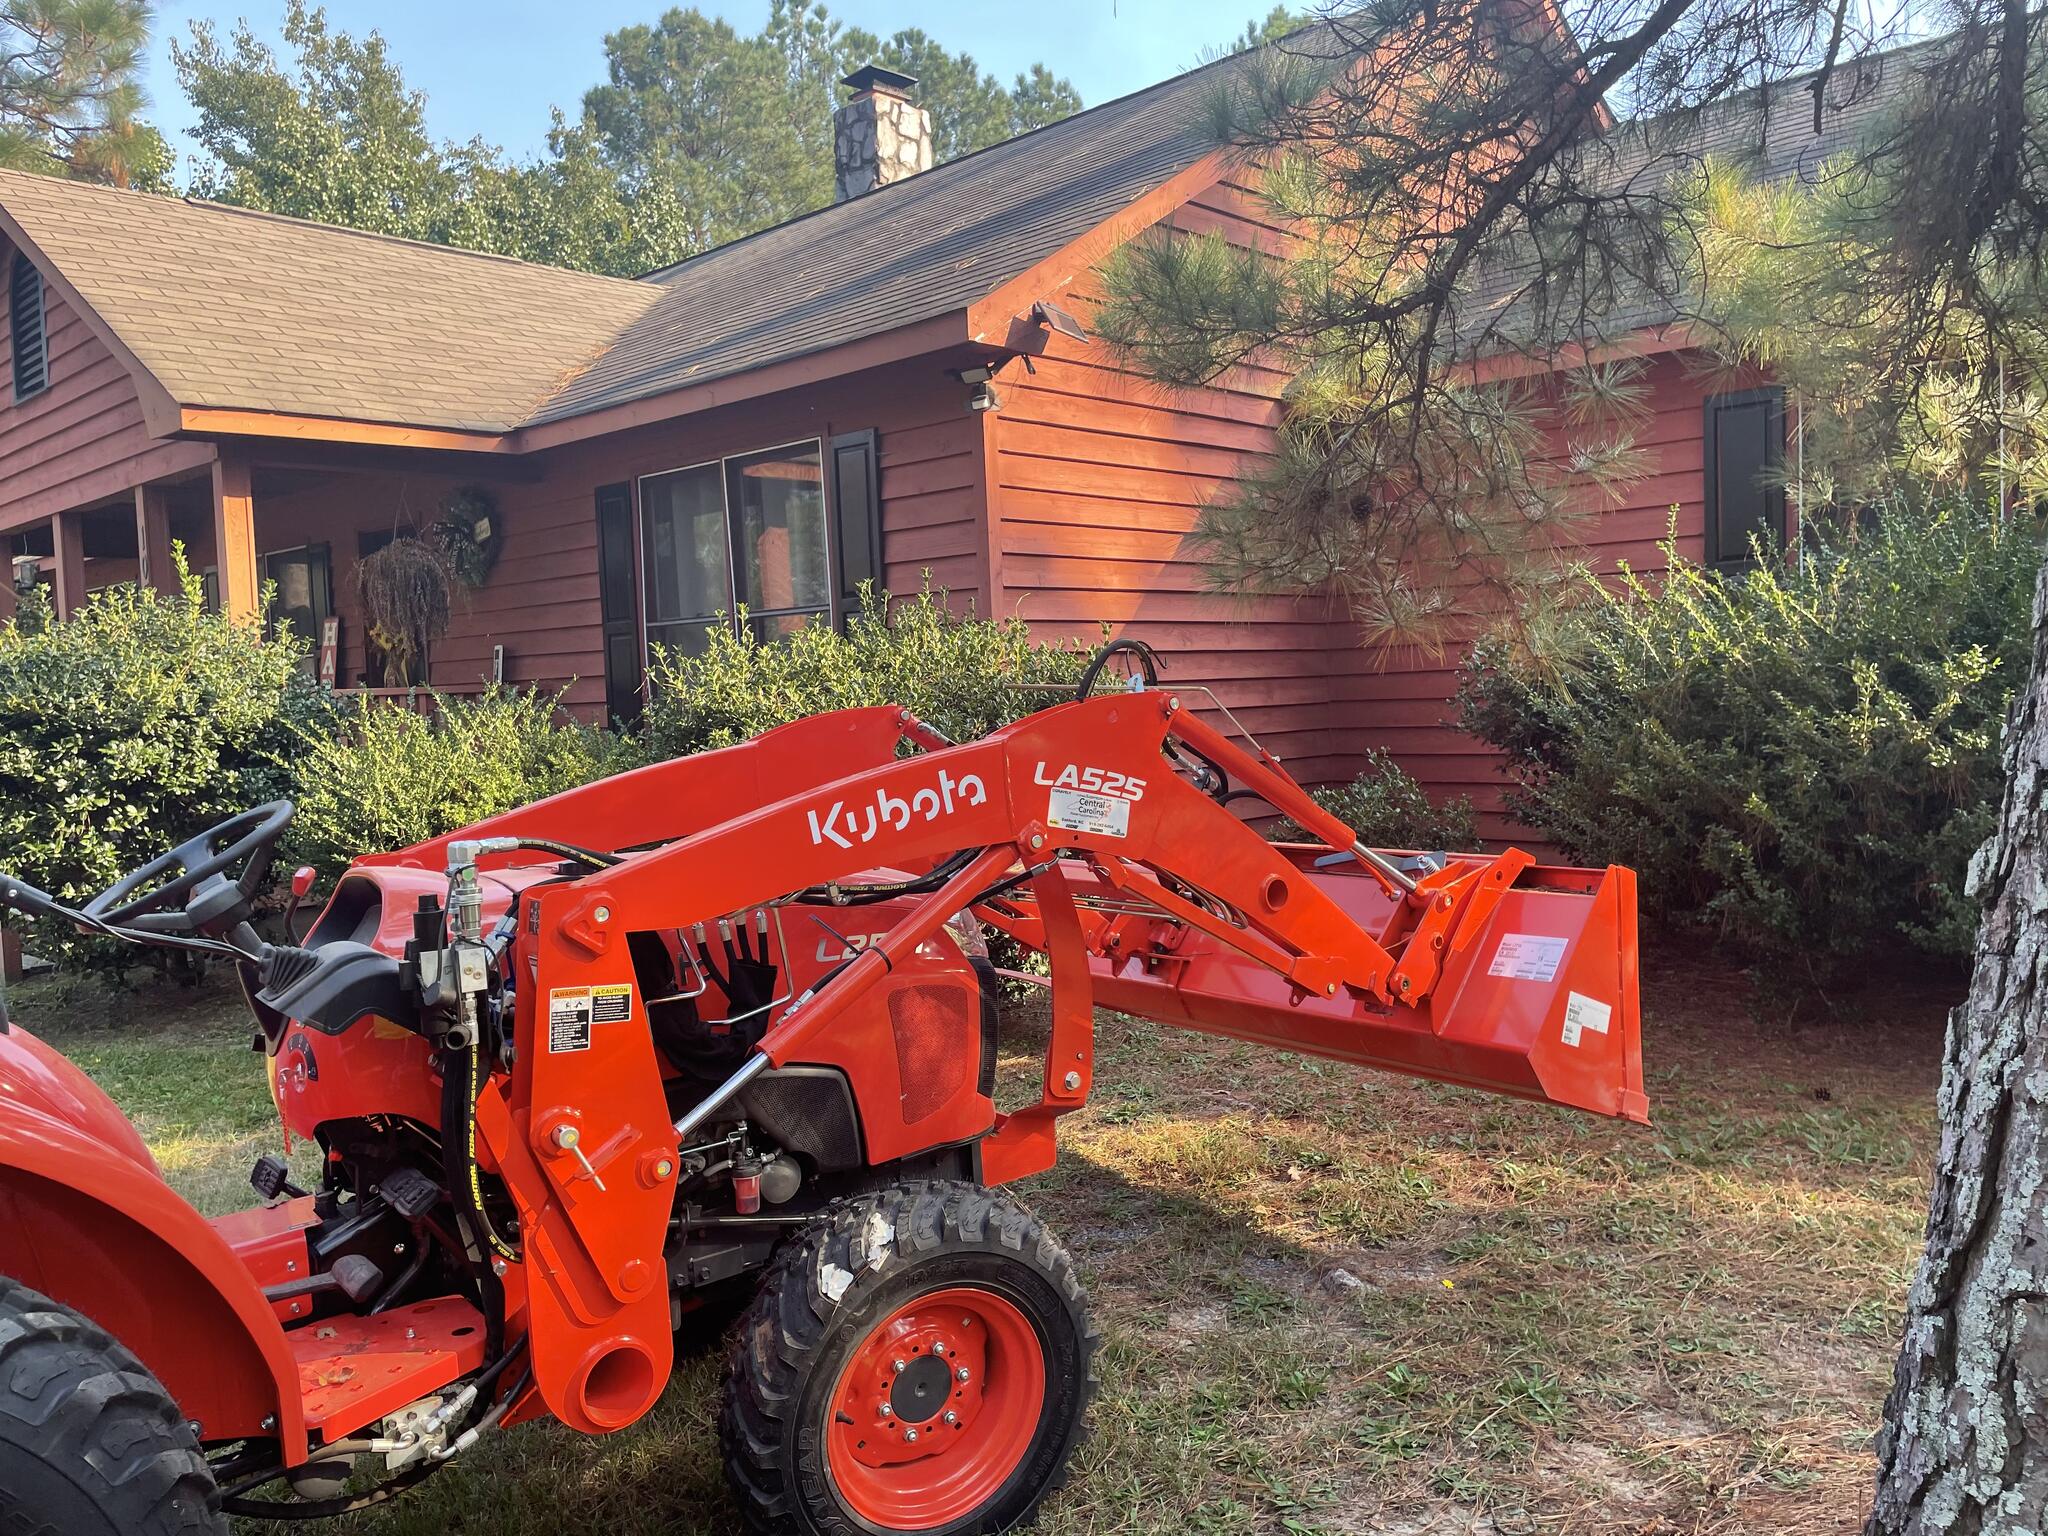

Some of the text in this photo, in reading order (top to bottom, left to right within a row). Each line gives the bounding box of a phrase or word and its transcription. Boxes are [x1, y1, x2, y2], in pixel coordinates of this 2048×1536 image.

[1033, 761, 1147, 802] LA525
[807, 769, 987, 848] Kubota
[1079, 797, 1106, 809] Central
[1078, 806, 1105, 817] Carolina
[560, 989, 588, 997] WARNING
[601, 987, 628, 995] CAUTION
